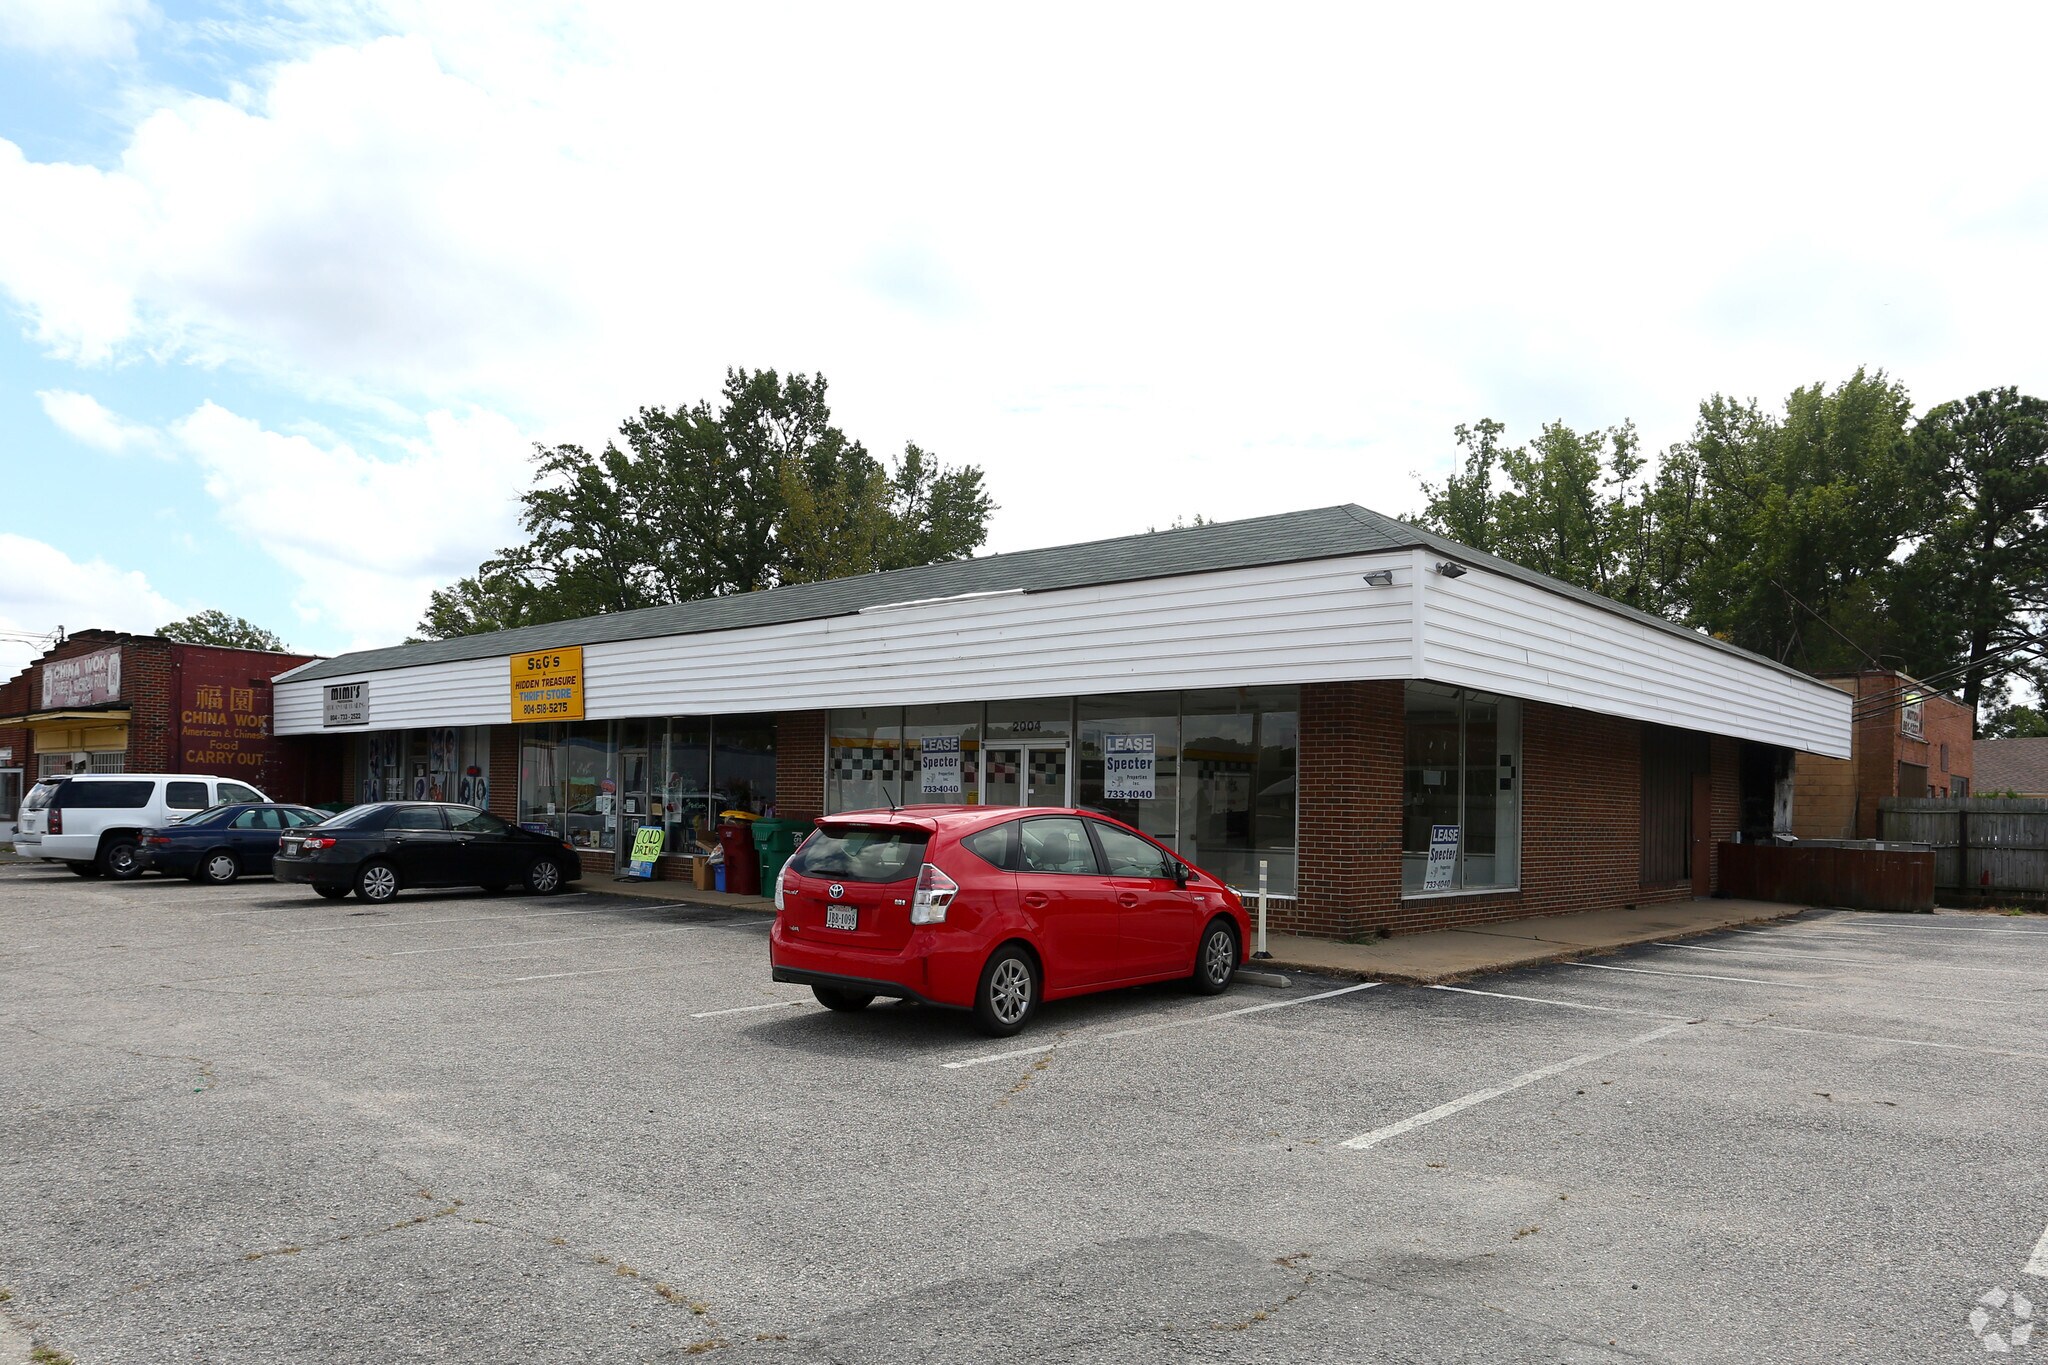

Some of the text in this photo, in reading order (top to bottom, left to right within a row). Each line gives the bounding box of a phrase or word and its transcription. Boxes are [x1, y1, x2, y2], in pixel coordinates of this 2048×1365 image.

[54, 655, 107, 679] CHINA WOK
[515, 675, 576, 690] HIDDEN TREASURE
[331, 686, 360, 700] MIMI'S
[519, 688, 572, 702] THRIFT STORE
[181, 710, 267, 728] CHINA WOK
[181, 726, 266, 739] American & Chinese
[1012, 721, 1041, 732] 2004
[209, 740, 239, 750] Food
[923, 738, 958, 750] LEASE
[1107, 738, 1152, 750] LEASE
[186, 750, 264, 766] CARRY OUT
[923, 756, 958, 770] Specter
[1107, 757, 1152, 772] Specter
[1107, 790, 1153, 798] 733-4040
[636, 829, 660, 844] COLD
[1432, 829, 1458, 842] LEASE
[634, 845, 659, 856] DRINKS
[1430, 848, 1455, 863] Specter
